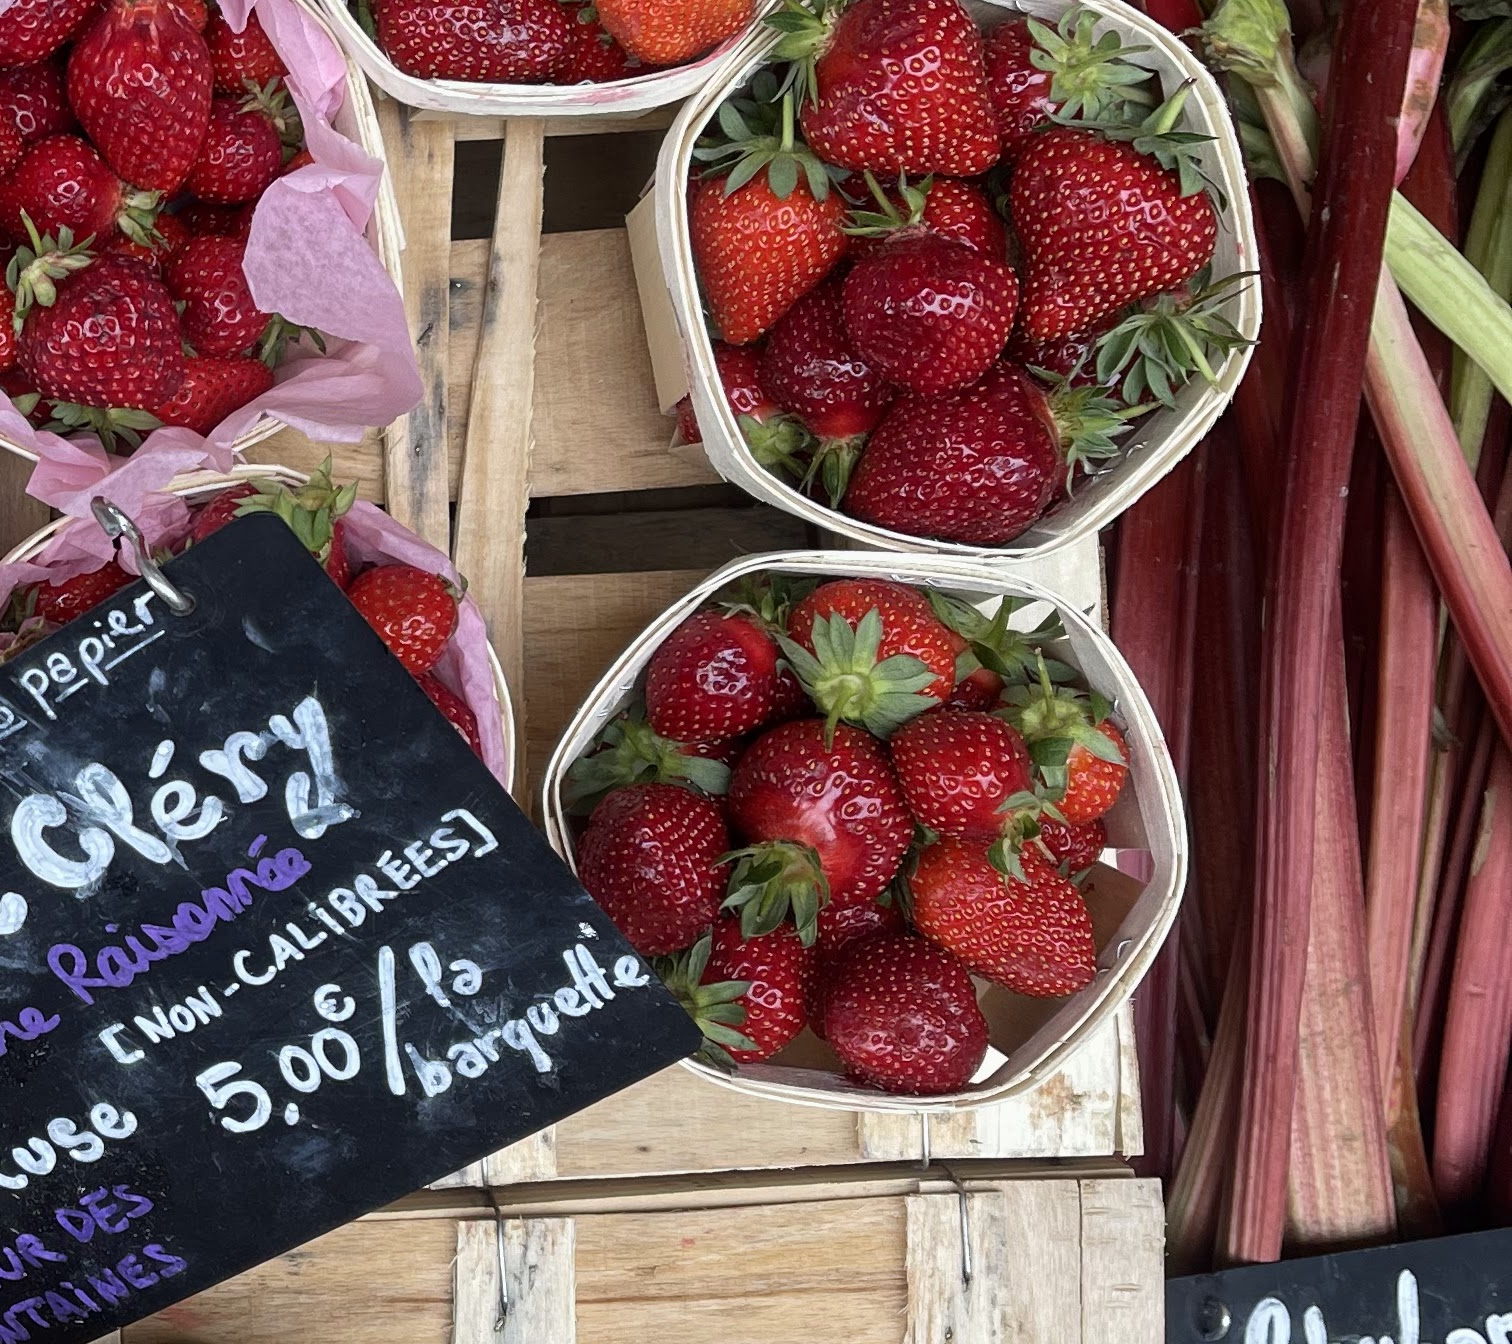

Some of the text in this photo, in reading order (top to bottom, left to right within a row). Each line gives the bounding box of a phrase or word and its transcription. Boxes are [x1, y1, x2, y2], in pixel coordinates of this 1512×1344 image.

[20, 591, 155, 720] papier
[11, 695, 353, 889] Cléry
[404, 943, 651, 1098] barquette
[55, 1184, 155, 1243] DES
